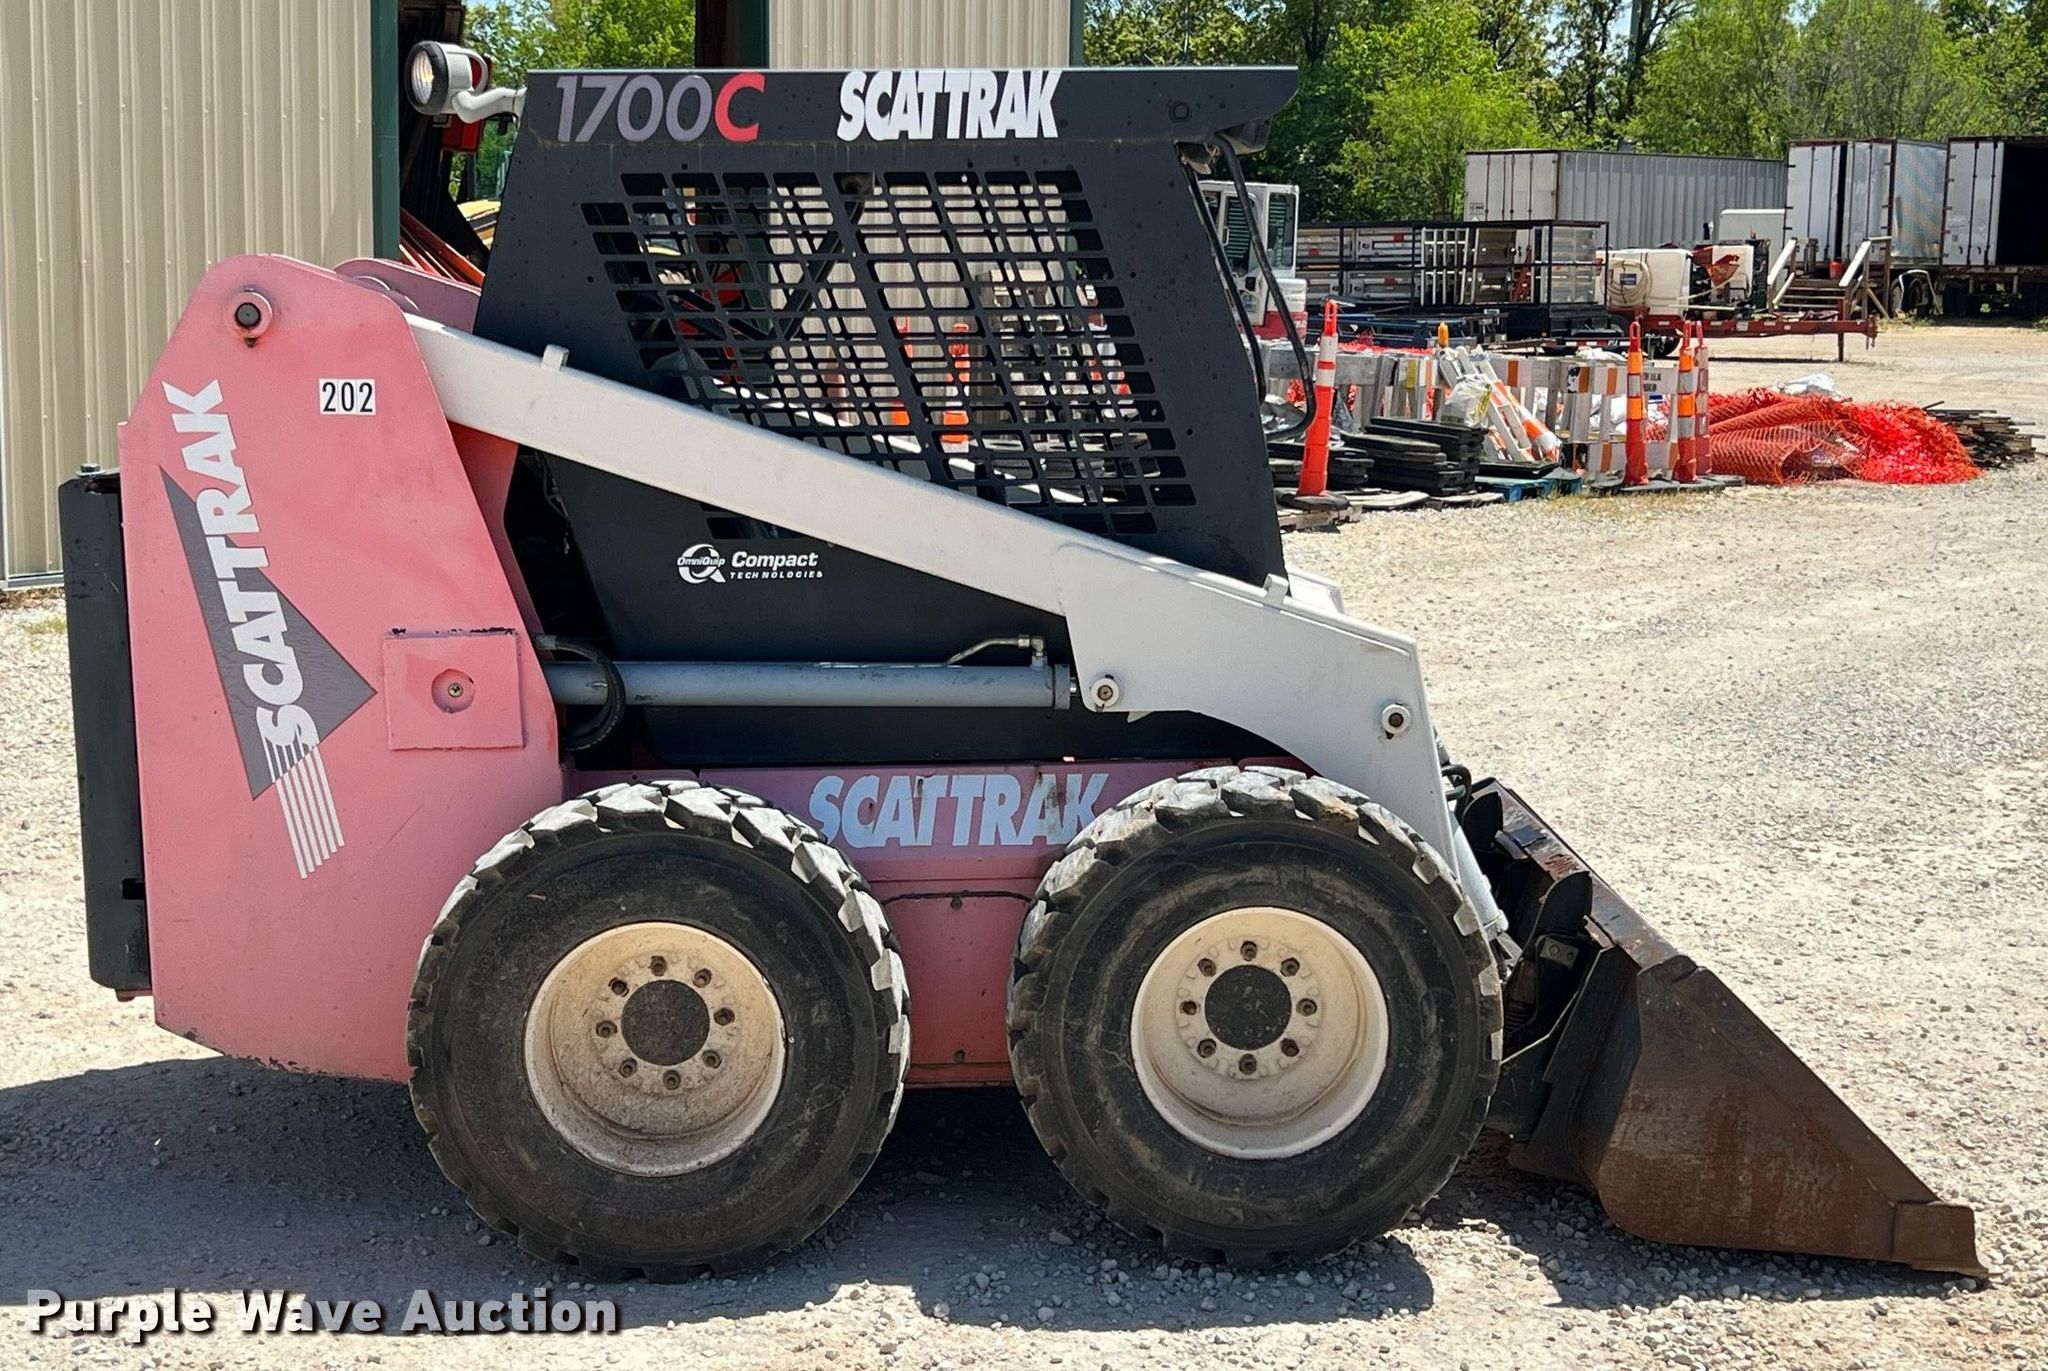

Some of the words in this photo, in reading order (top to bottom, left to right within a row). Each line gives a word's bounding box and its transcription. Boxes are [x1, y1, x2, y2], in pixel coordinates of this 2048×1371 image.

[557, 72, 766, 142] 1700C
[837, 70, 1059, 140] SCATTRAK
[322, 381, 373, 413] 202
[162, 379, 322, 758] SCATTRAK
[731, 551, 819, 571] Compact
[809, 773, 1109, 849] SCATTRAK
